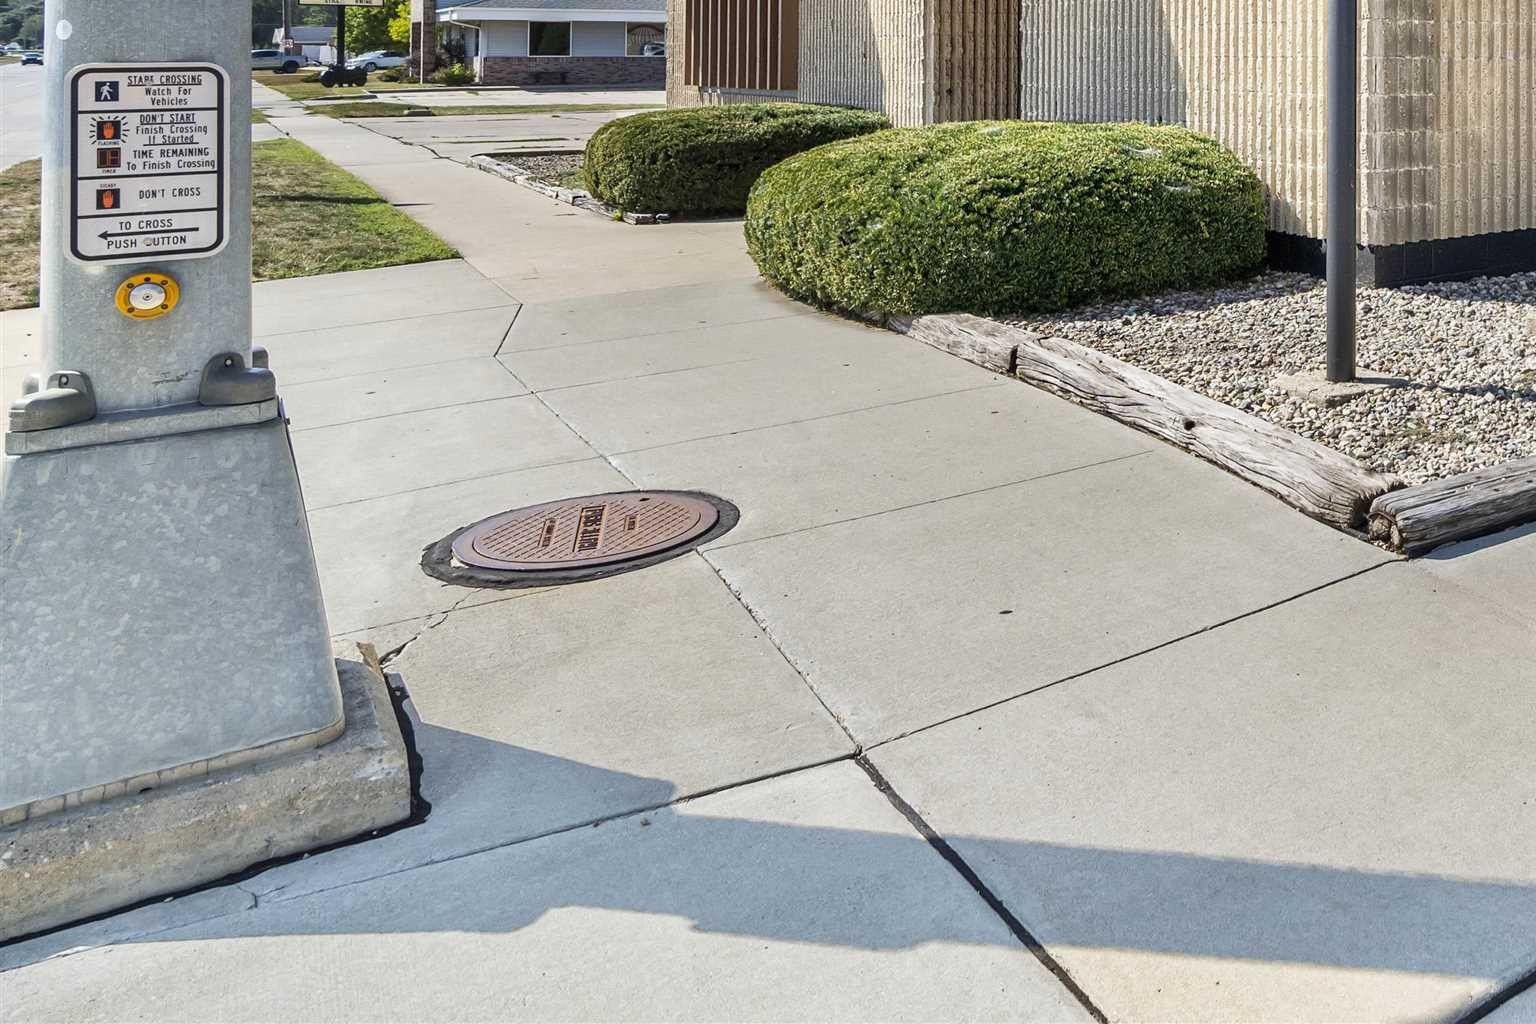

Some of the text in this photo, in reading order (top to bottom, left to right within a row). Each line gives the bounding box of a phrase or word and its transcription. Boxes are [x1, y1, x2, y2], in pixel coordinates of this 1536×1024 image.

[160, 74, 202, 85] CROSSING
[145, 86, 192, 96] Watch For
[150, 97, 188, 106] Vehicles
[139, 113, 195, 123] DON'T START
[136, 124, 208, 135] Finish Crossing
[162, 135, 194, 144] Started
[133, 148, 209, 159] TIME REMAINING
[127, 159, 216, 171] To Finish Crossing
[139, 187, 201, 200] DON'T CROSS
[119, 218, 173, 231] TO CROSS
[107, 235, 187, 249] PUSH UTTON
